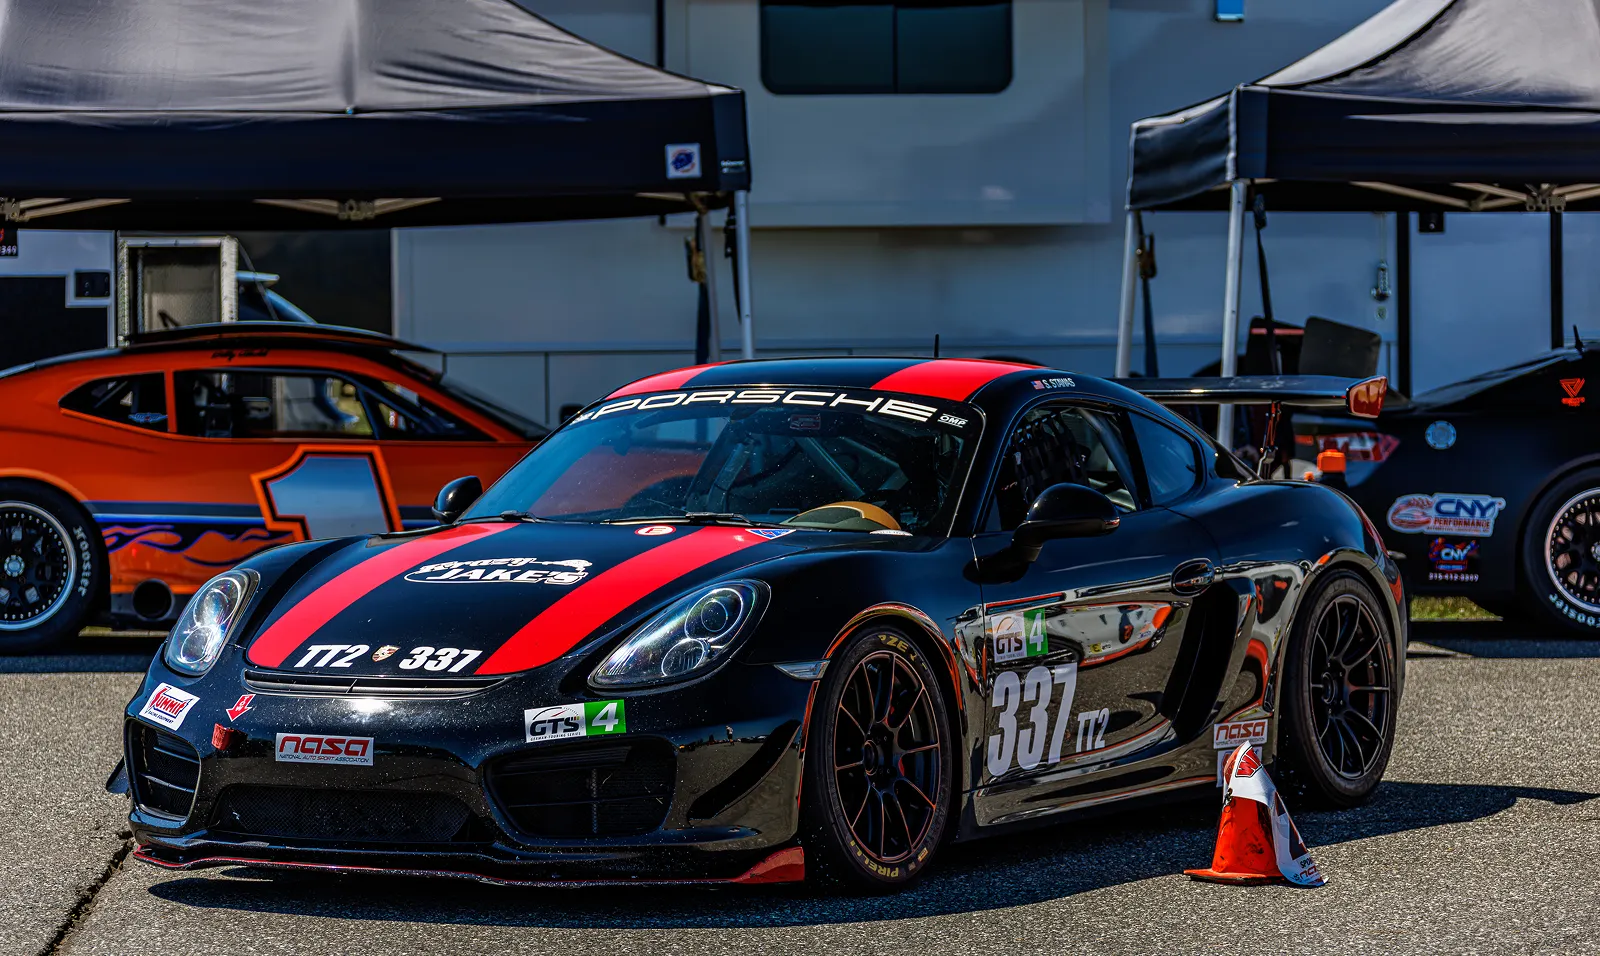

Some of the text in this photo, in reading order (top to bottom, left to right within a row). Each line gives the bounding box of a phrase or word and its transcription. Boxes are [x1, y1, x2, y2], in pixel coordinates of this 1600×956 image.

[591, 390, 938, 422] PORSCHE
[939, 414, 967, 427] OMP
[251, 444, 404, 542] 1
[1435, 498, 1497, 518] CNY
[1433, 517, 1490, 528] PERFORMANCE
[1441, 546, 1471, 561] CNY
[426, 568, 588, 585] JAKE'S
[996, 613, 1044, 655] GTS 4
[294, 644, 483, 673] TT2 337
[530, 702, 619, 737] GTS 4
[987, 663, 1110, 777] 337 TT2
[850, 840, 899, 878] PIRELLI
